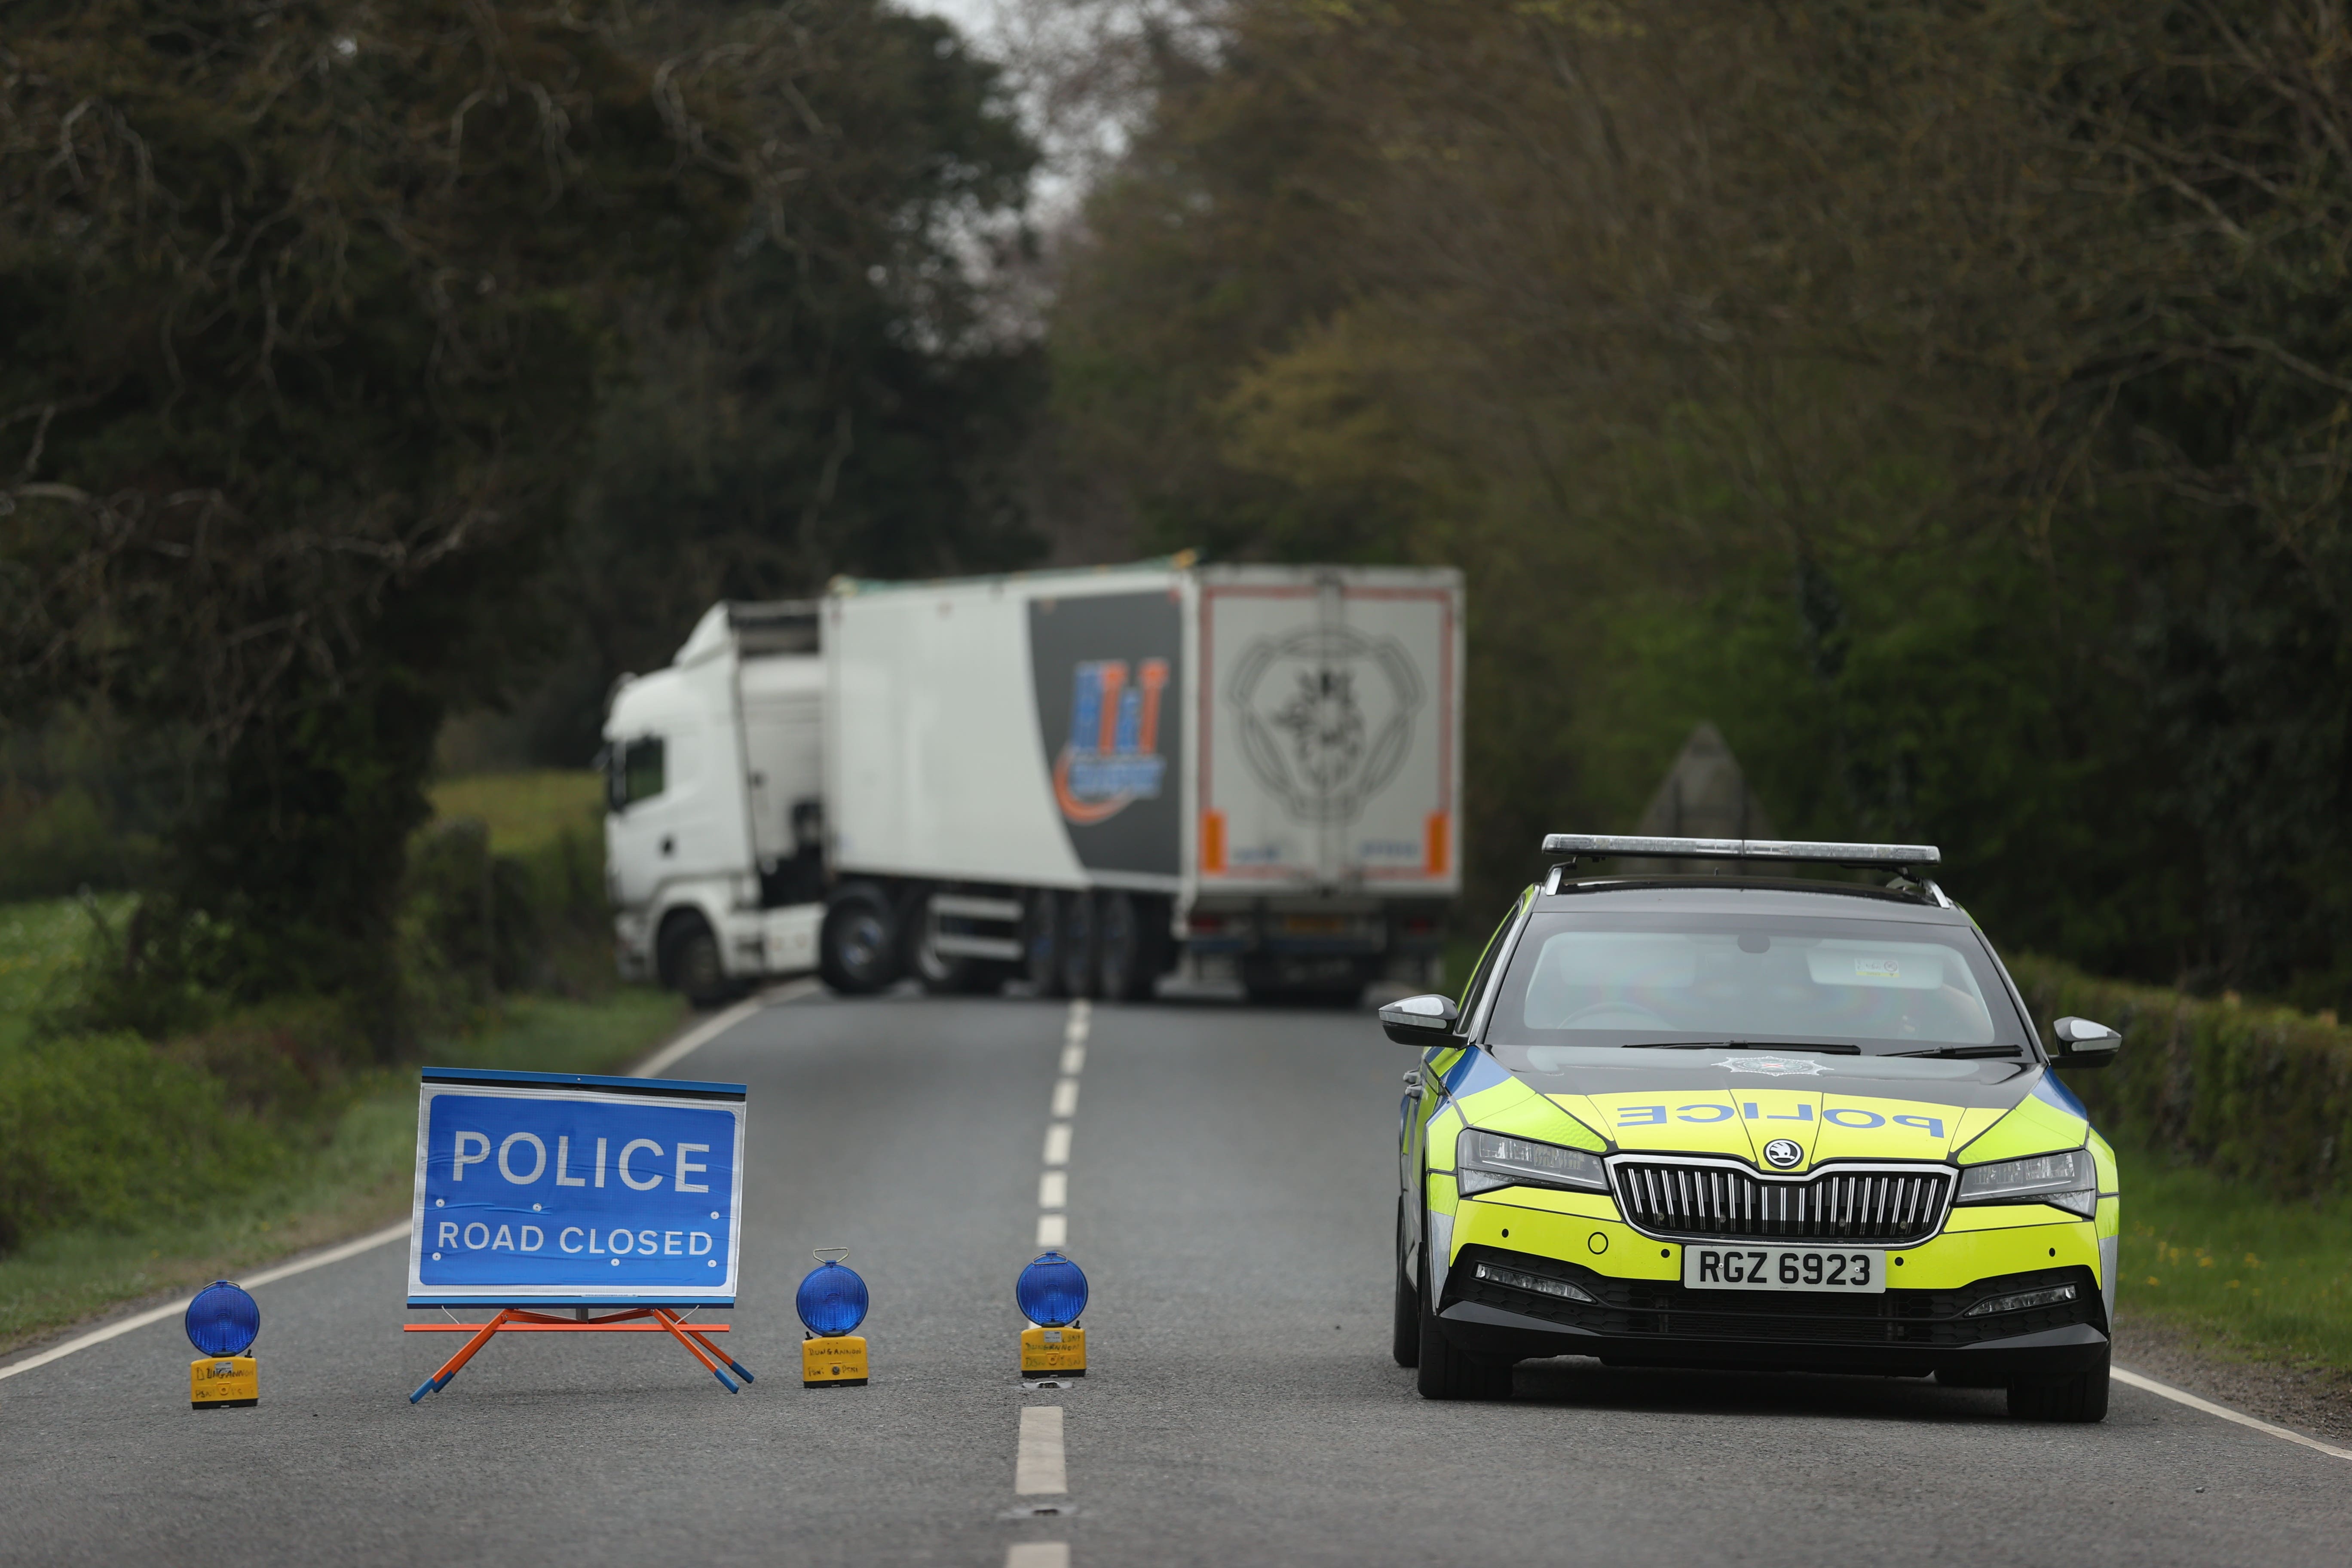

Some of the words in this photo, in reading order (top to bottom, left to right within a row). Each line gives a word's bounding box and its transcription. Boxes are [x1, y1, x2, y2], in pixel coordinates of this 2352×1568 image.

[453, 1131, 710, 1193] POLICE
[438, 1222, 545, 1251] ROAD
[560, 1227, 713, 1255] CLOSED
[1700, 1251, 1767, 1283] RGZ
[1779, 1253, 1870, 1286] 6923
